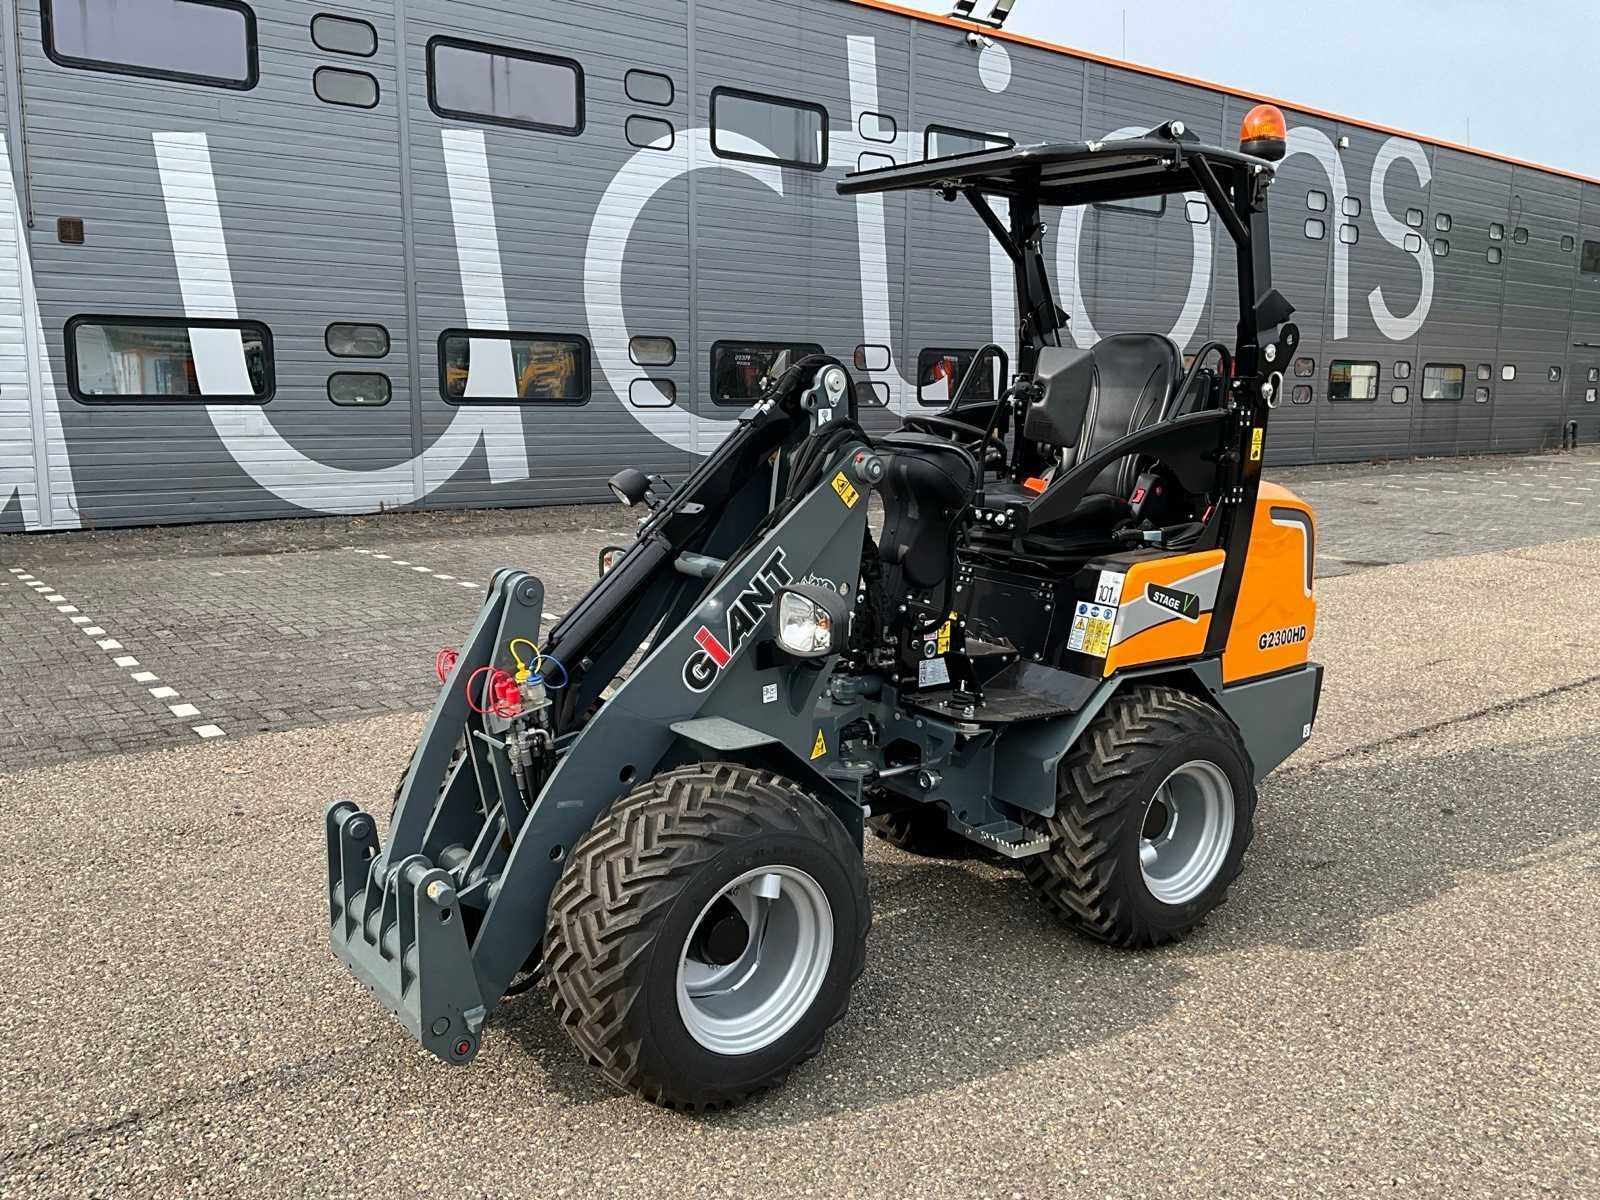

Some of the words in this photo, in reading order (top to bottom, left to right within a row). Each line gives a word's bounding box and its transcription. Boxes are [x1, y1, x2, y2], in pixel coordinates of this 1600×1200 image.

[1098, 584, 1114, 604] 101
[1153, 591, 1181, 610] STAGE
[1183, 592, 1198, 613] V
[682, 546, 793, 693] GIANT
[1258, 626, 1306, 650] G2300HD
